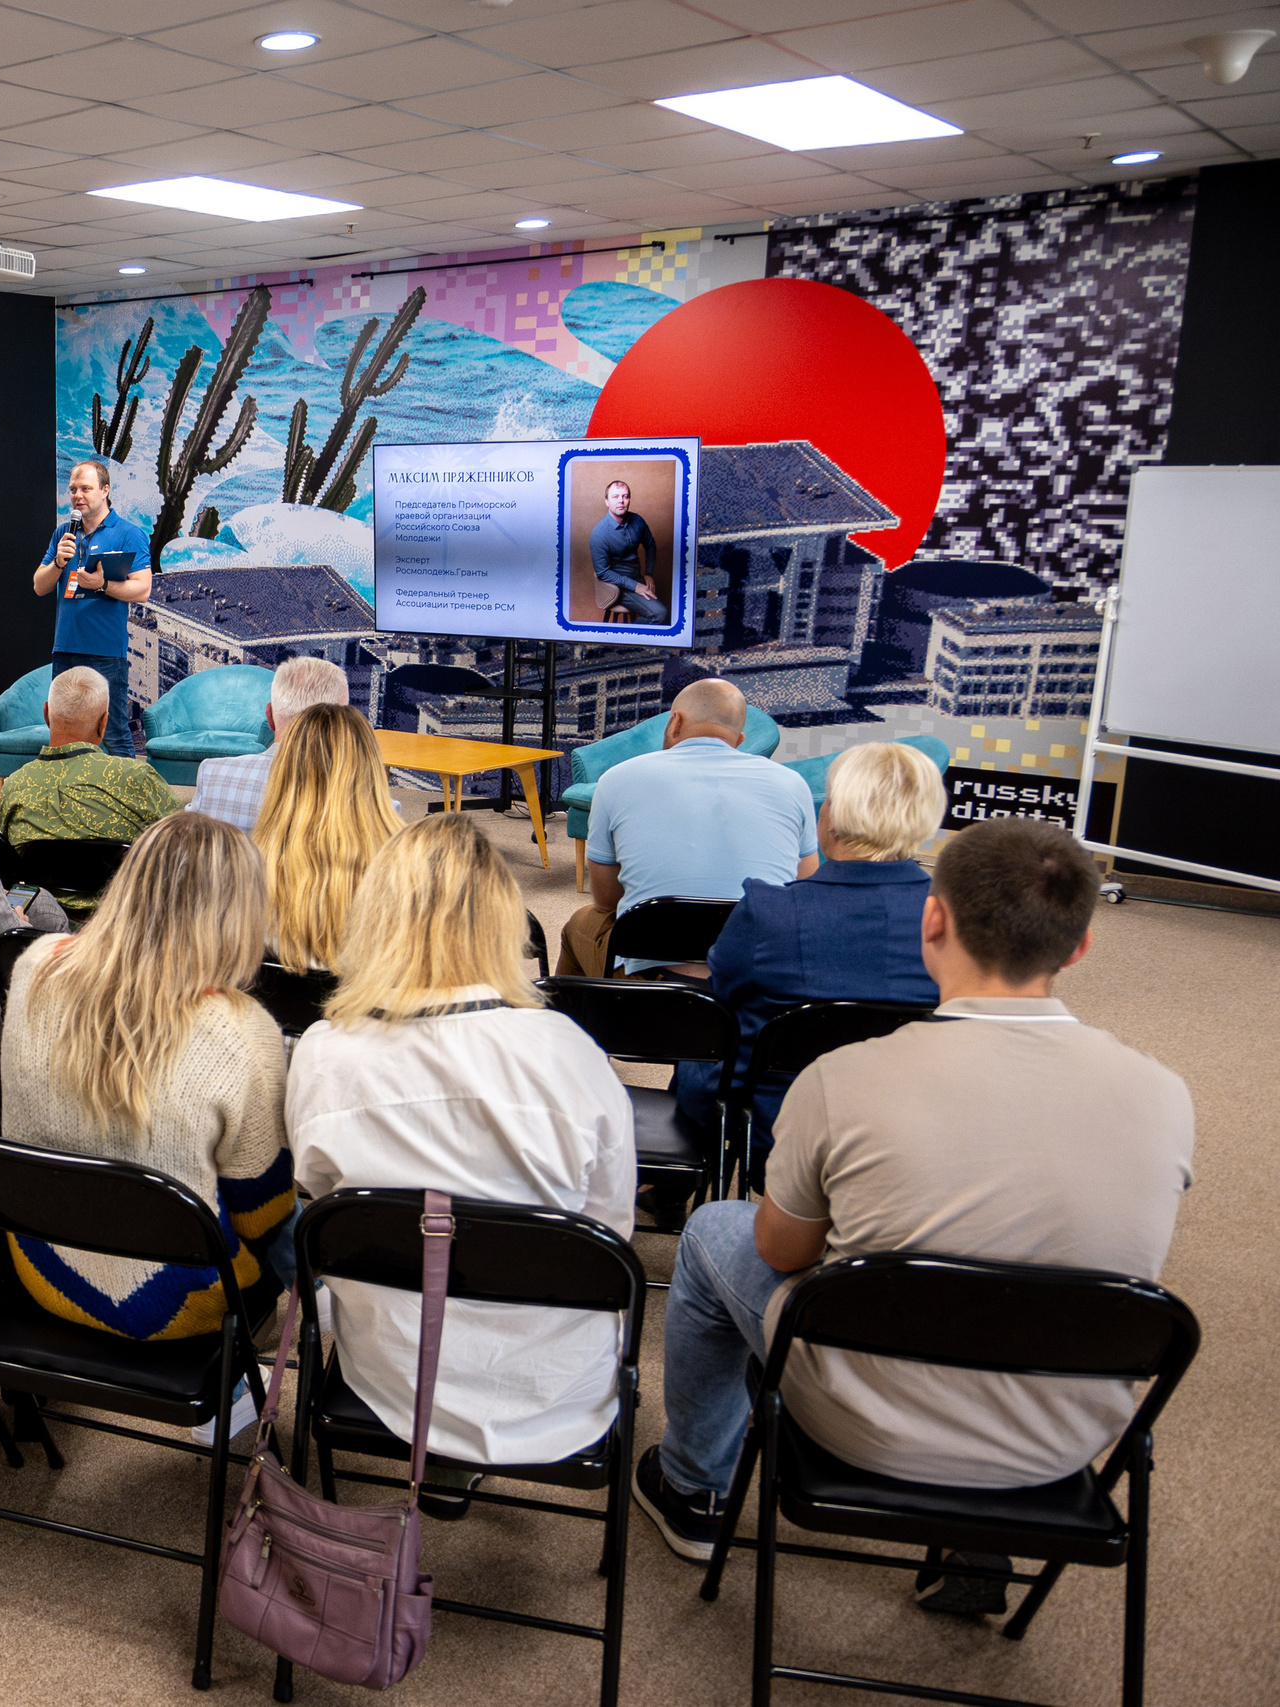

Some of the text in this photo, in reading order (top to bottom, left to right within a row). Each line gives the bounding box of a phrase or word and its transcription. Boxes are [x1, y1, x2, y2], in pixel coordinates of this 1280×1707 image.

[388, 471, 535, 483] МАКСИМ ПРЯЖЕННИКОВ
[395, 500, 517, 510] Председатель Приморской
[395, 511, 491, 521] краевой организации
[395, 522, 481, 532] Российского Союза
[395, 534, 441, 543] Молодежи
[395, 556, 431, 565] Эксперт
[395, 566, 488, 578] Росмолодежь.Гранты
[395, 588, 490, 600] Федеральный тренер
[395, 599, 515, 612] Ассоциации тренеров РСМ
